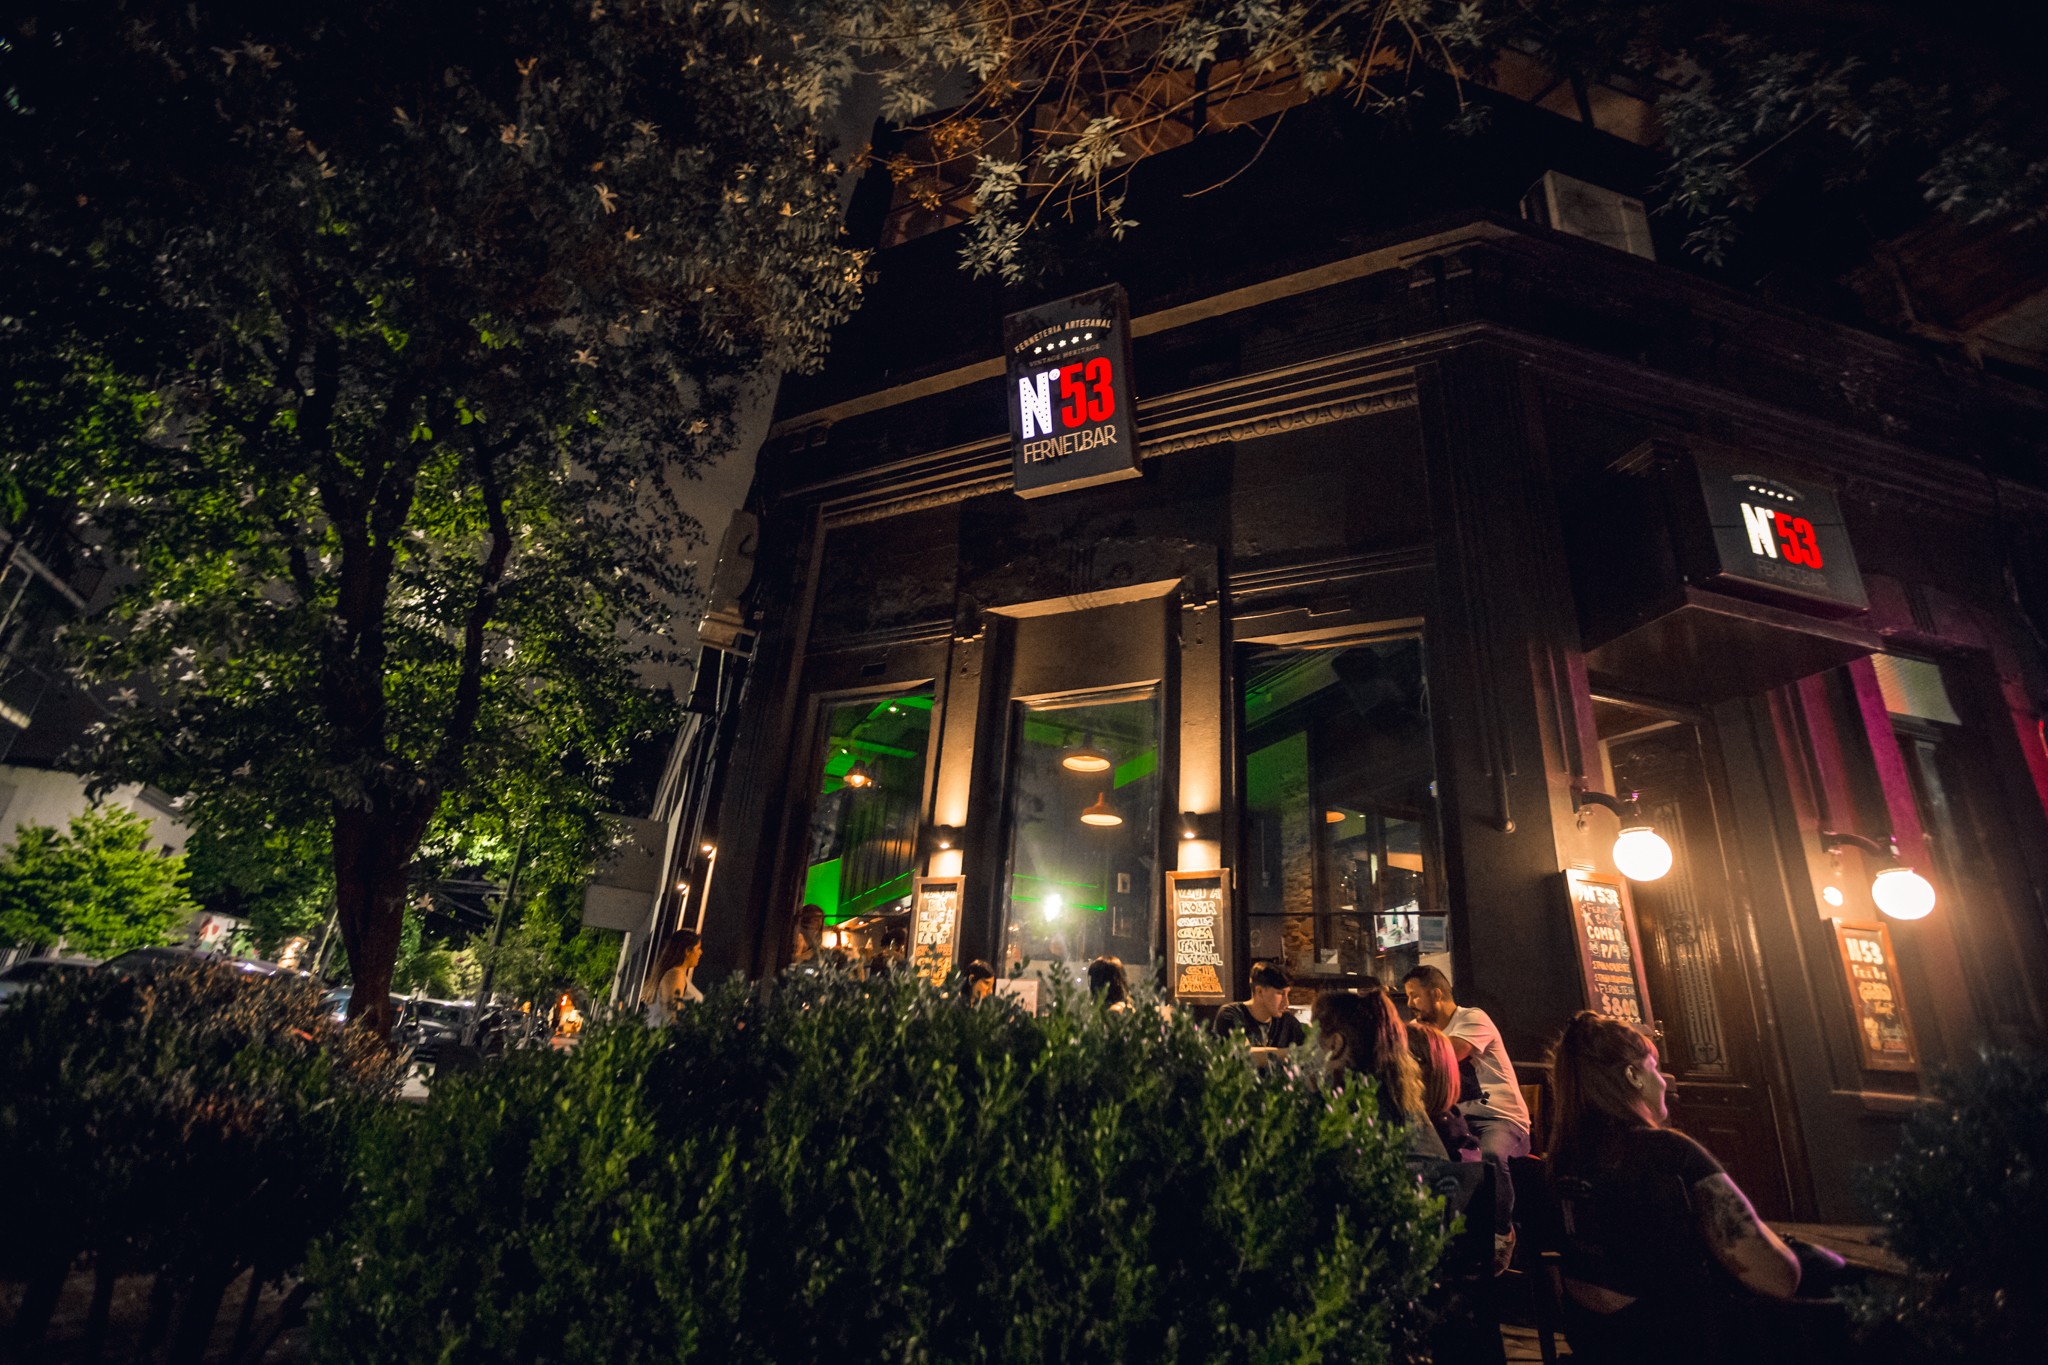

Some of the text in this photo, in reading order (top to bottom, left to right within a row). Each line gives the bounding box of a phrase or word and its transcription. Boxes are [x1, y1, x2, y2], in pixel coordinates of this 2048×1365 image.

[1064, 318, 1113, 331] ARTESANAL
[1586, 925, 1621, 942] COMBO
[1601, 994, 1639, 1017] $800
